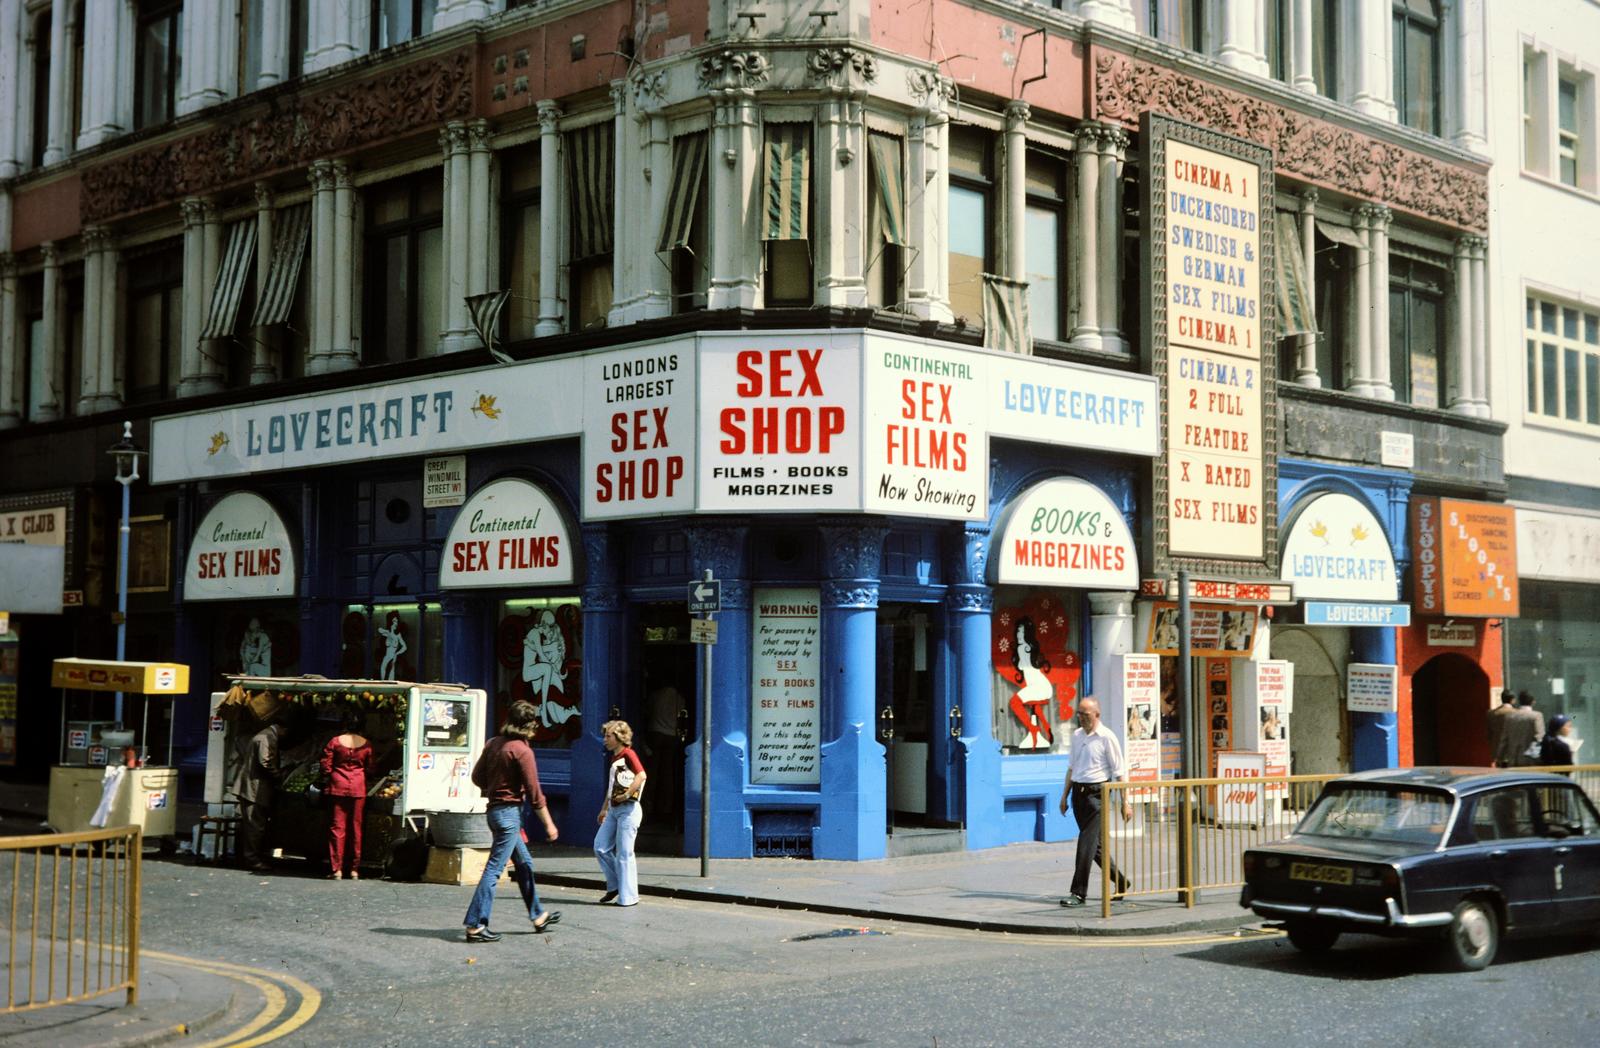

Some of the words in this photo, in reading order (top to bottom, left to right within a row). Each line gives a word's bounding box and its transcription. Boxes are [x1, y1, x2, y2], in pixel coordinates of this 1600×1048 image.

[1174, 159, 1233, 194] CINEMA
[1242, 178, 1247, 197] 1
[1170, 191, 1256, 232] UNCENSORED
[1172, 225, 1237, 259] SWEDISH
[1244, 242, 1254, 262] &
[1183, 255, 1245, 288] GERMAN
[1173, 283, 1202, 308] SEX
[1211, 290, 1256, 319] FILMS
[1178, 315, 1238, 346] CINEMA
[1246, 329, 1252, 348] 1
[603, 354, 678, 380] LONDONS
[736, 348, 824, 398] SEX
[884, 352, 973, 380] CONTINENTAL
[1179, 357, 1239, 387] CINEMA
[1246, 369, 1253, 389] 2
[606, 379, 674, 403] LARGEST
[902, 378, 952, 424] SEX
[1004, 380, 1145, 428] LOVECRAFT
[1189, 388, 1197, 410] 2
[1208, 391, 1243, 416] FULL
[247, 390, 453, 457] LOVECRAFT
[611, 406, 669, 453] SEX
[719, 406, 845, 455] SHOP
[886, 424, 967, 472] FILMS
[1185, 424, 1249, 452] FEATURE
[427, 460, 448, 472] GREAT
[427, 471, 461, 483] WINDMILL
[596, 455, 684, 503] SHOP
[713, 467, 765, 478] FILMS
[788, 466, 848, 478] BOOKS
[1181, 461, 1191, 482] X
[1205, 463, 1251, 488] RATED
[427, 483, 450, 495] STREET
[452, 483, 461, 493] W1
[728, 484, 833, 496] MAGAZINES
[879, 473, 908, 501] Now
[914, 477, 976, 513] Showing
[6, 517, 16, 536] X
[22, 513, 55, 535] CLUB
[470, 508, 541, 533] Continental
[1030, 507, 1101, 536] BOOKS
[1104, 522, 1113, 538] &
[1174, 498, 1202, 520] SEX
[1212, 501, 1257, 525] FILMS
[212, 520, 267, 543] Continental
[198, 552, 226, 579] SEX
[234, 548, 281, 577] FILMS
[453, 540, 490, 572] SEX
[498, 536, 559, 570] FILMS
[1015, 539, 1125, 571] MAGAZINES
[1293, 554, 1386, 581] LOVECRAFT
[1420, 503, 1435, 609] SLOOPYS
[1449, 512, 1511, 602] SLOOPYS
[1142, 581, 1163, 596] SEX
[760, 604, 818, 615] WARNING
[1327, 605, 1392, 623] LOVECRAFT
[760, 625, 773, 634] For
[807, 626, 817, 635] by
[763, 637, 779, 645] that
[803, 637, 813, 645] be
[761, 648, 798, 656] offended
[802, 648, 811, 658] by
[777, 660, 797, 669] SEX
[760, 679, 777, 687] SEX
[784, 679, 815, 687] BOOKS
[761, 700, 778, 708] SEX
[787, 700, 815, 708] FILMS
[792, 742, 815, 750] under
[794, 731, 812, 740] shop
[778, 764, 814, 772] admitted
[1225, 791, 1257, 804] NOW
